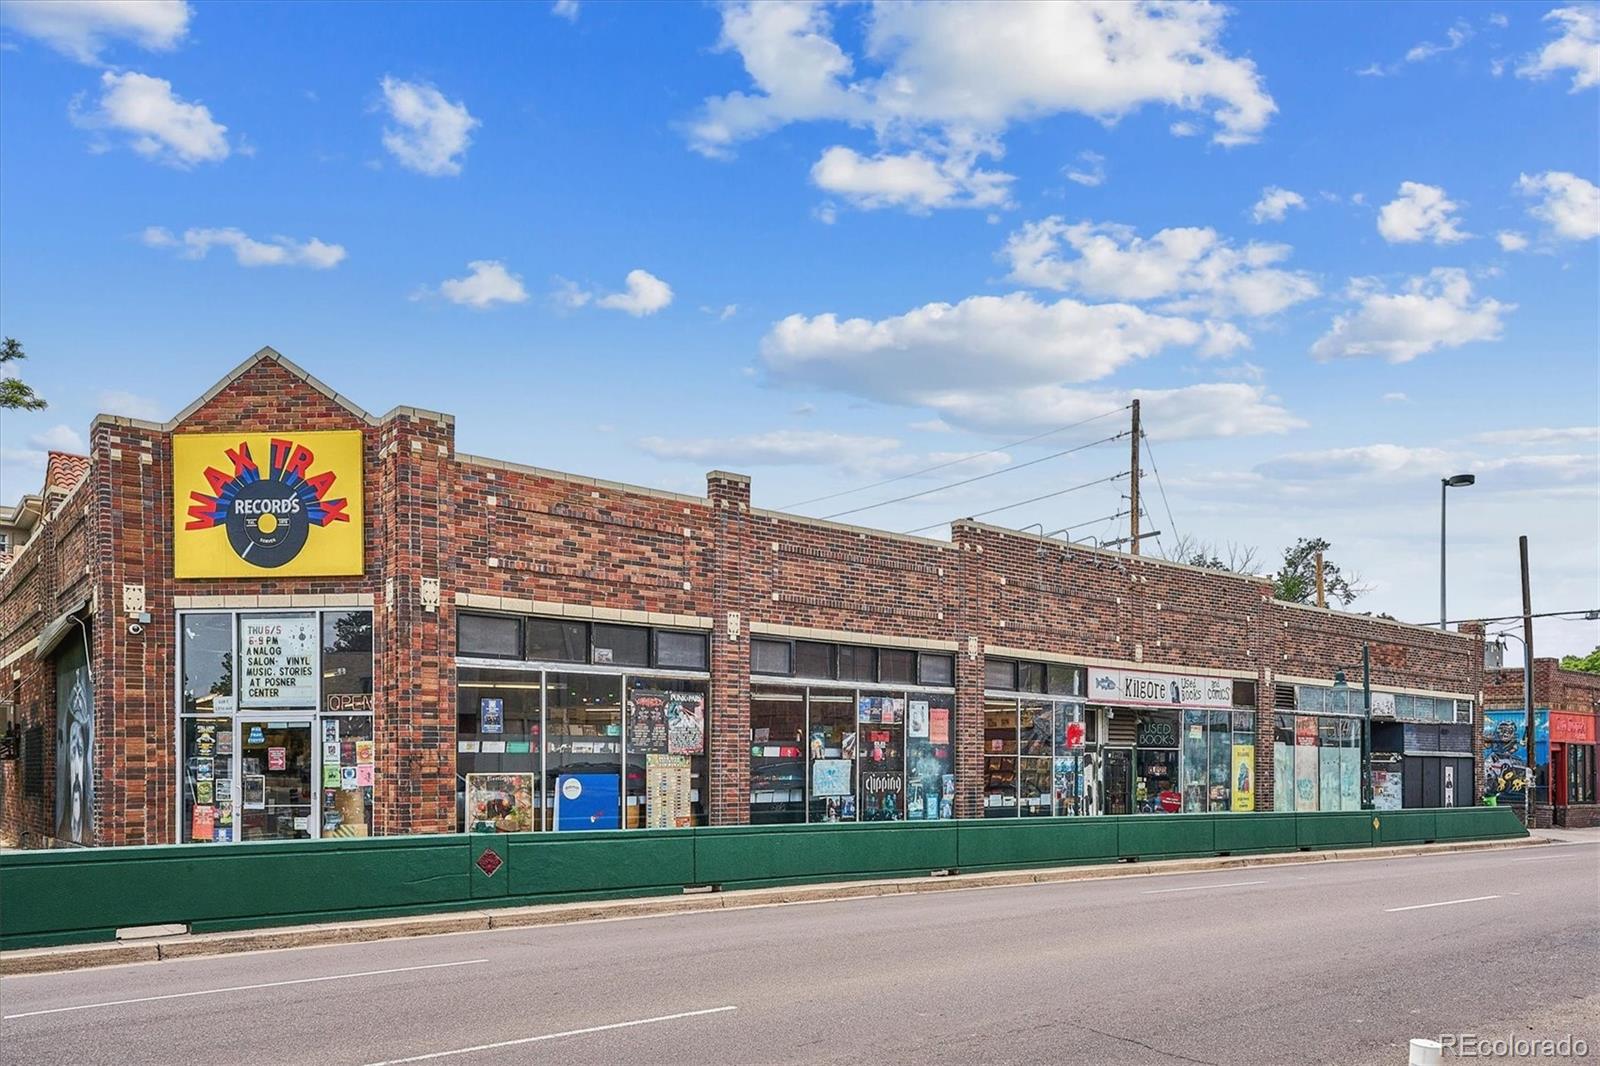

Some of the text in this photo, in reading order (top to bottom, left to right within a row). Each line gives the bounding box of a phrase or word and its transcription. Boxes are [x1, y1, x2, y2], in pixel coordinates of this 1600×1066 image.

[185, 438, 350, 531] WAX TRAX
[235, 498, 300, 515] RECORDS
[266, 636, 279, 645] PM
[246, 646, 282, 655] ANALOG
[286, 656, 310, 665] VINYL
[279, 667, 313, 676] STORIES
[249, 677, 296, 687] AT POSNER
[248, 688, 279, 697] CENTER
[1125, 678, 1166, 701] Kilgore
[329, 695, 373, 711] OPEN
[1143, 723, 1172, 735] USED
[1139, 734, 1176, 745] BOOKS
